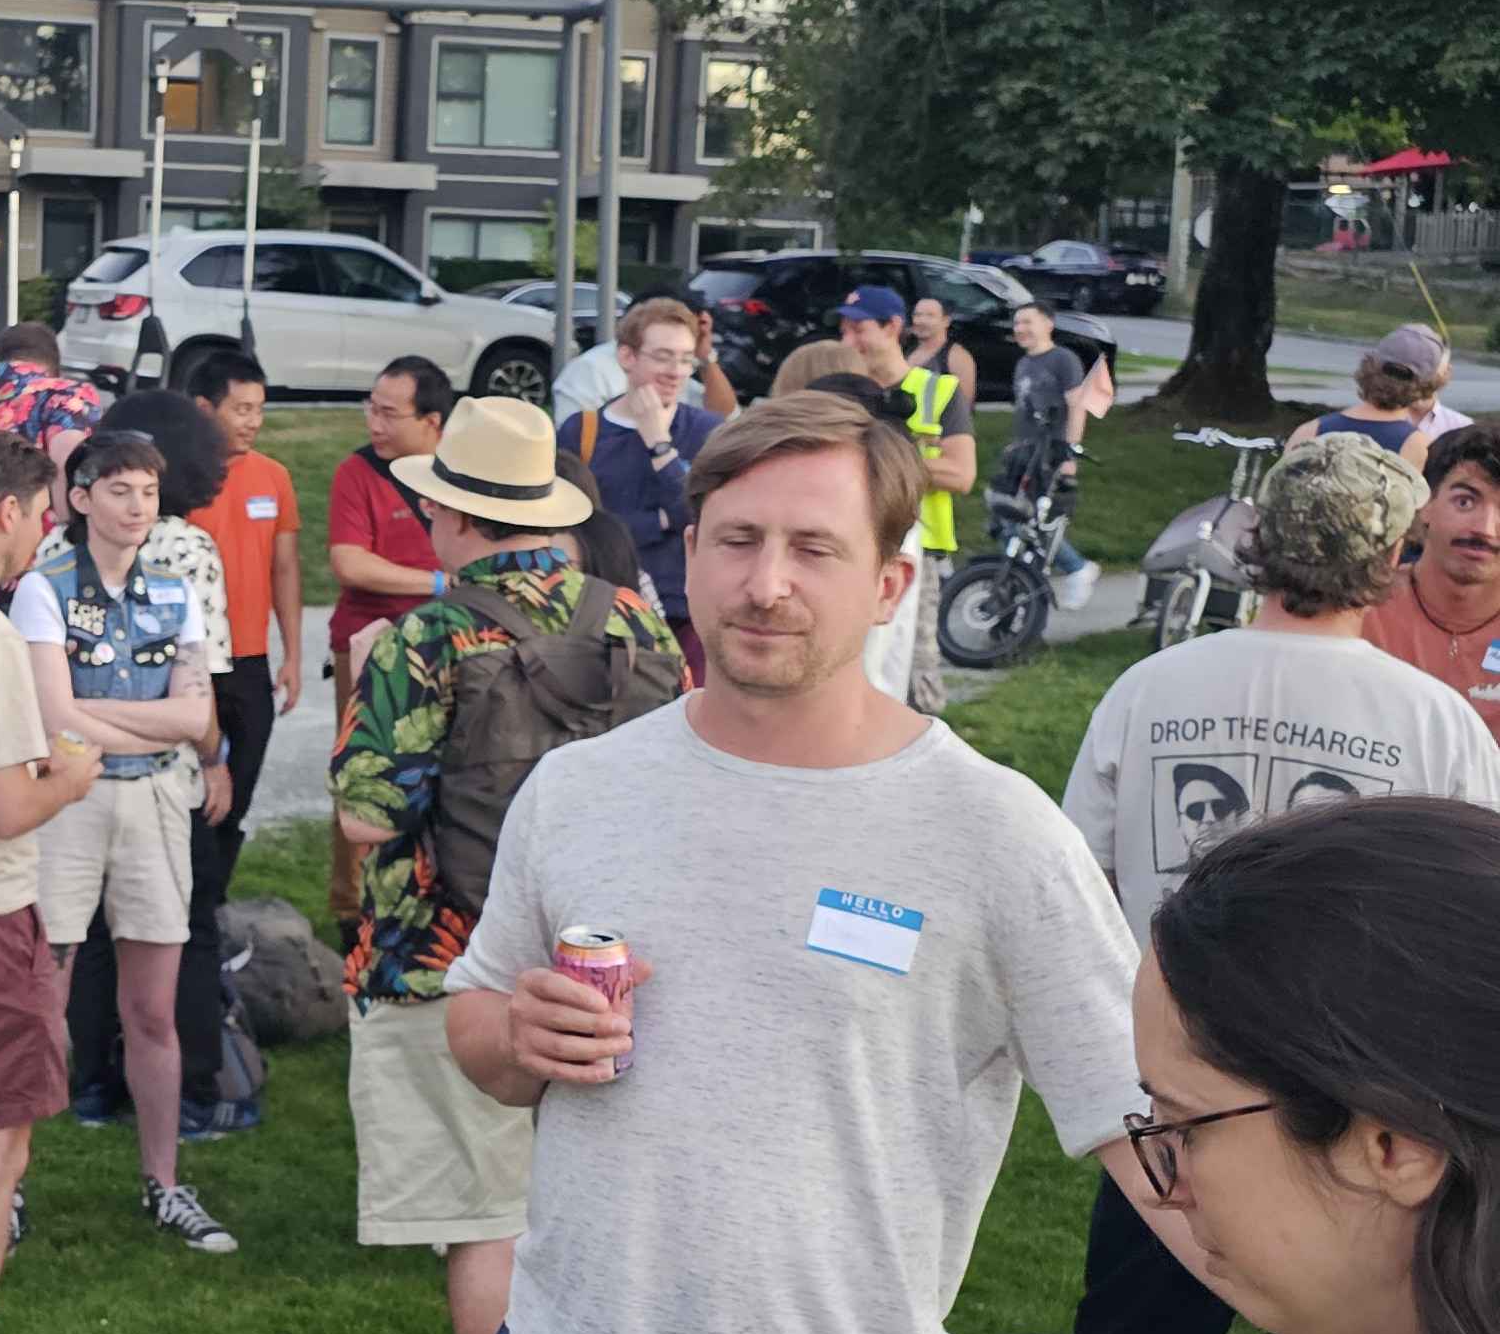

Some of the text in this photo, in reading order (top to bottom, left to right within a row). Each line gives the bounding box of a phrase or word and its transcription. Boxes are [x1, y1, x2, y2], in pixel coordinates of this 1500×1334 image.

[1150, 716, 1402, 767] DROP THE CHARGES
[841, 892, 904, 919] HELLO
